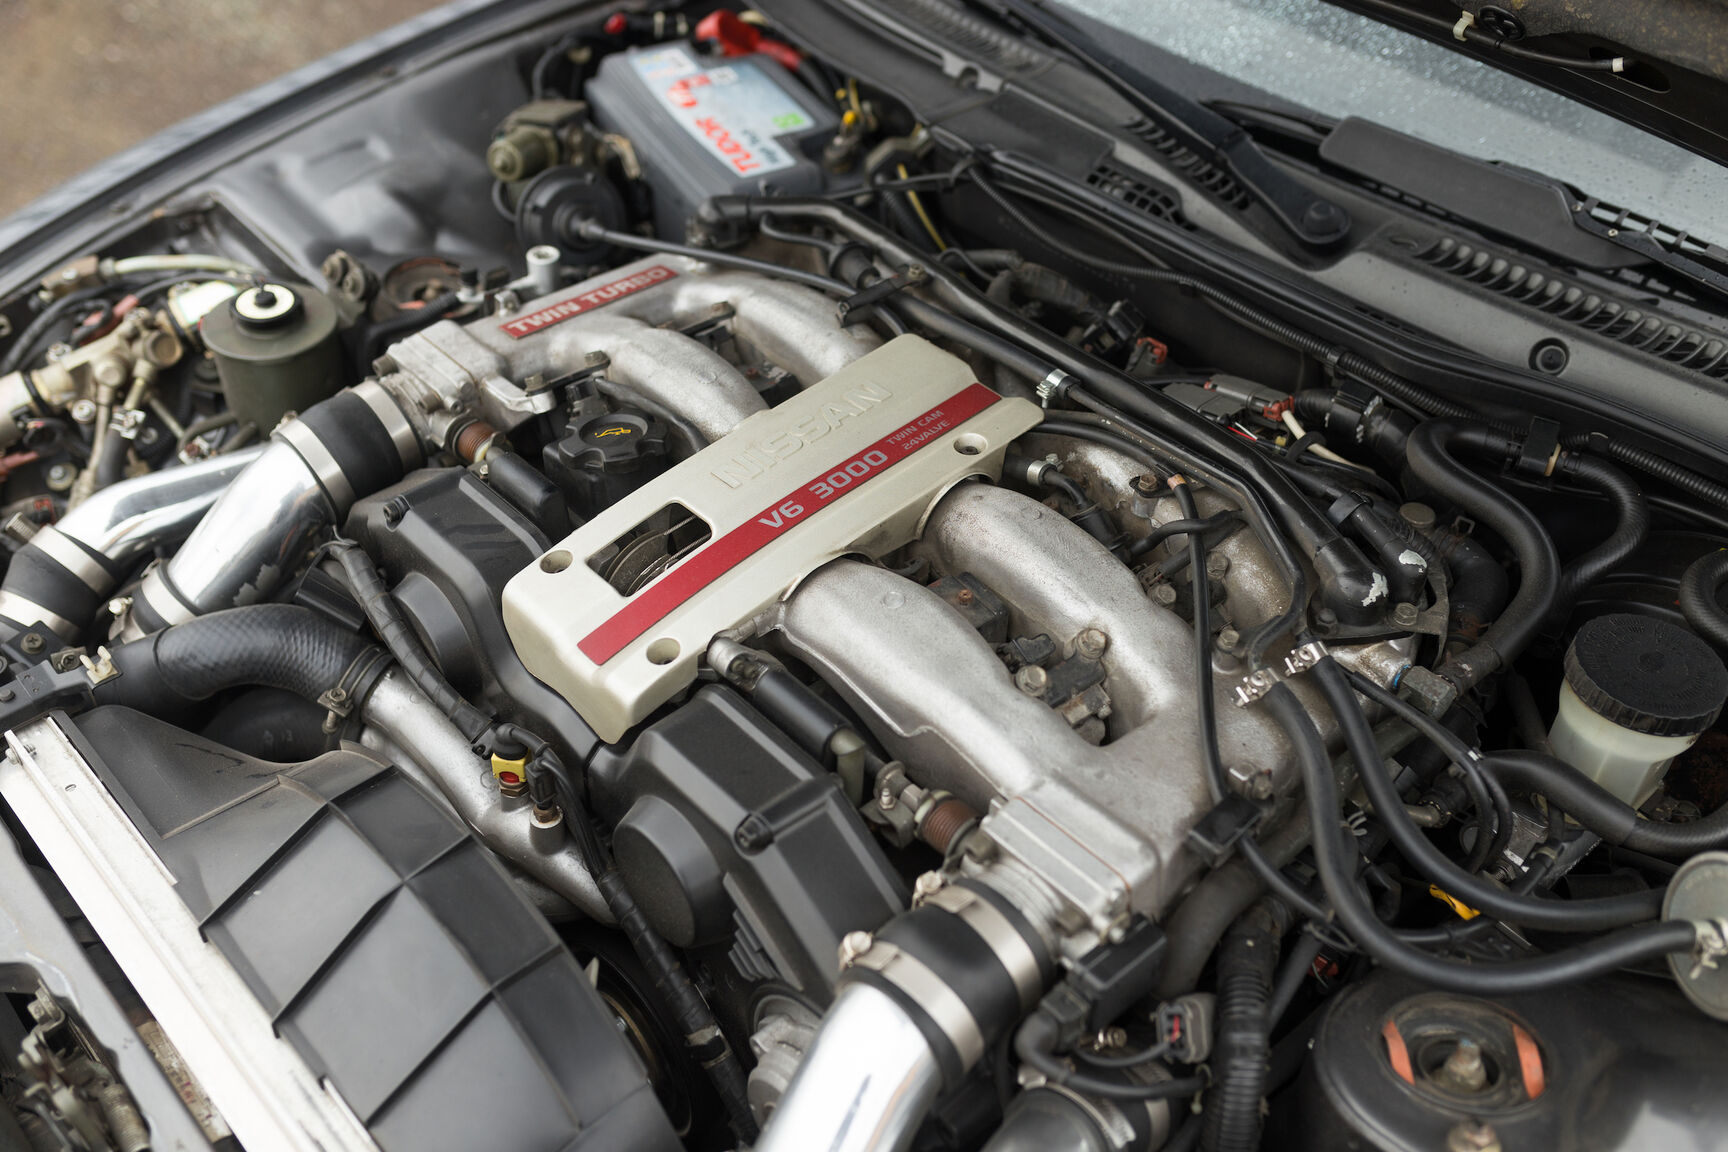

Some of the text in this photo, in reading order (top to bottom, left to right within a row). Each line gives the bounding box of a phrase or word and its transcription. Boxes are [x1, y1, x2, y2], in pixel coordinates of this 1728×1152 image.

[507, 268, 668, 332] TWIN TURBO
[711, 381, 894, 489] NISSAN
[886, 409, 944, 446] TWIN CAM
[903, 420, 951, 451] 24VALVE
[758, 450, 888, 530] V6 3000
